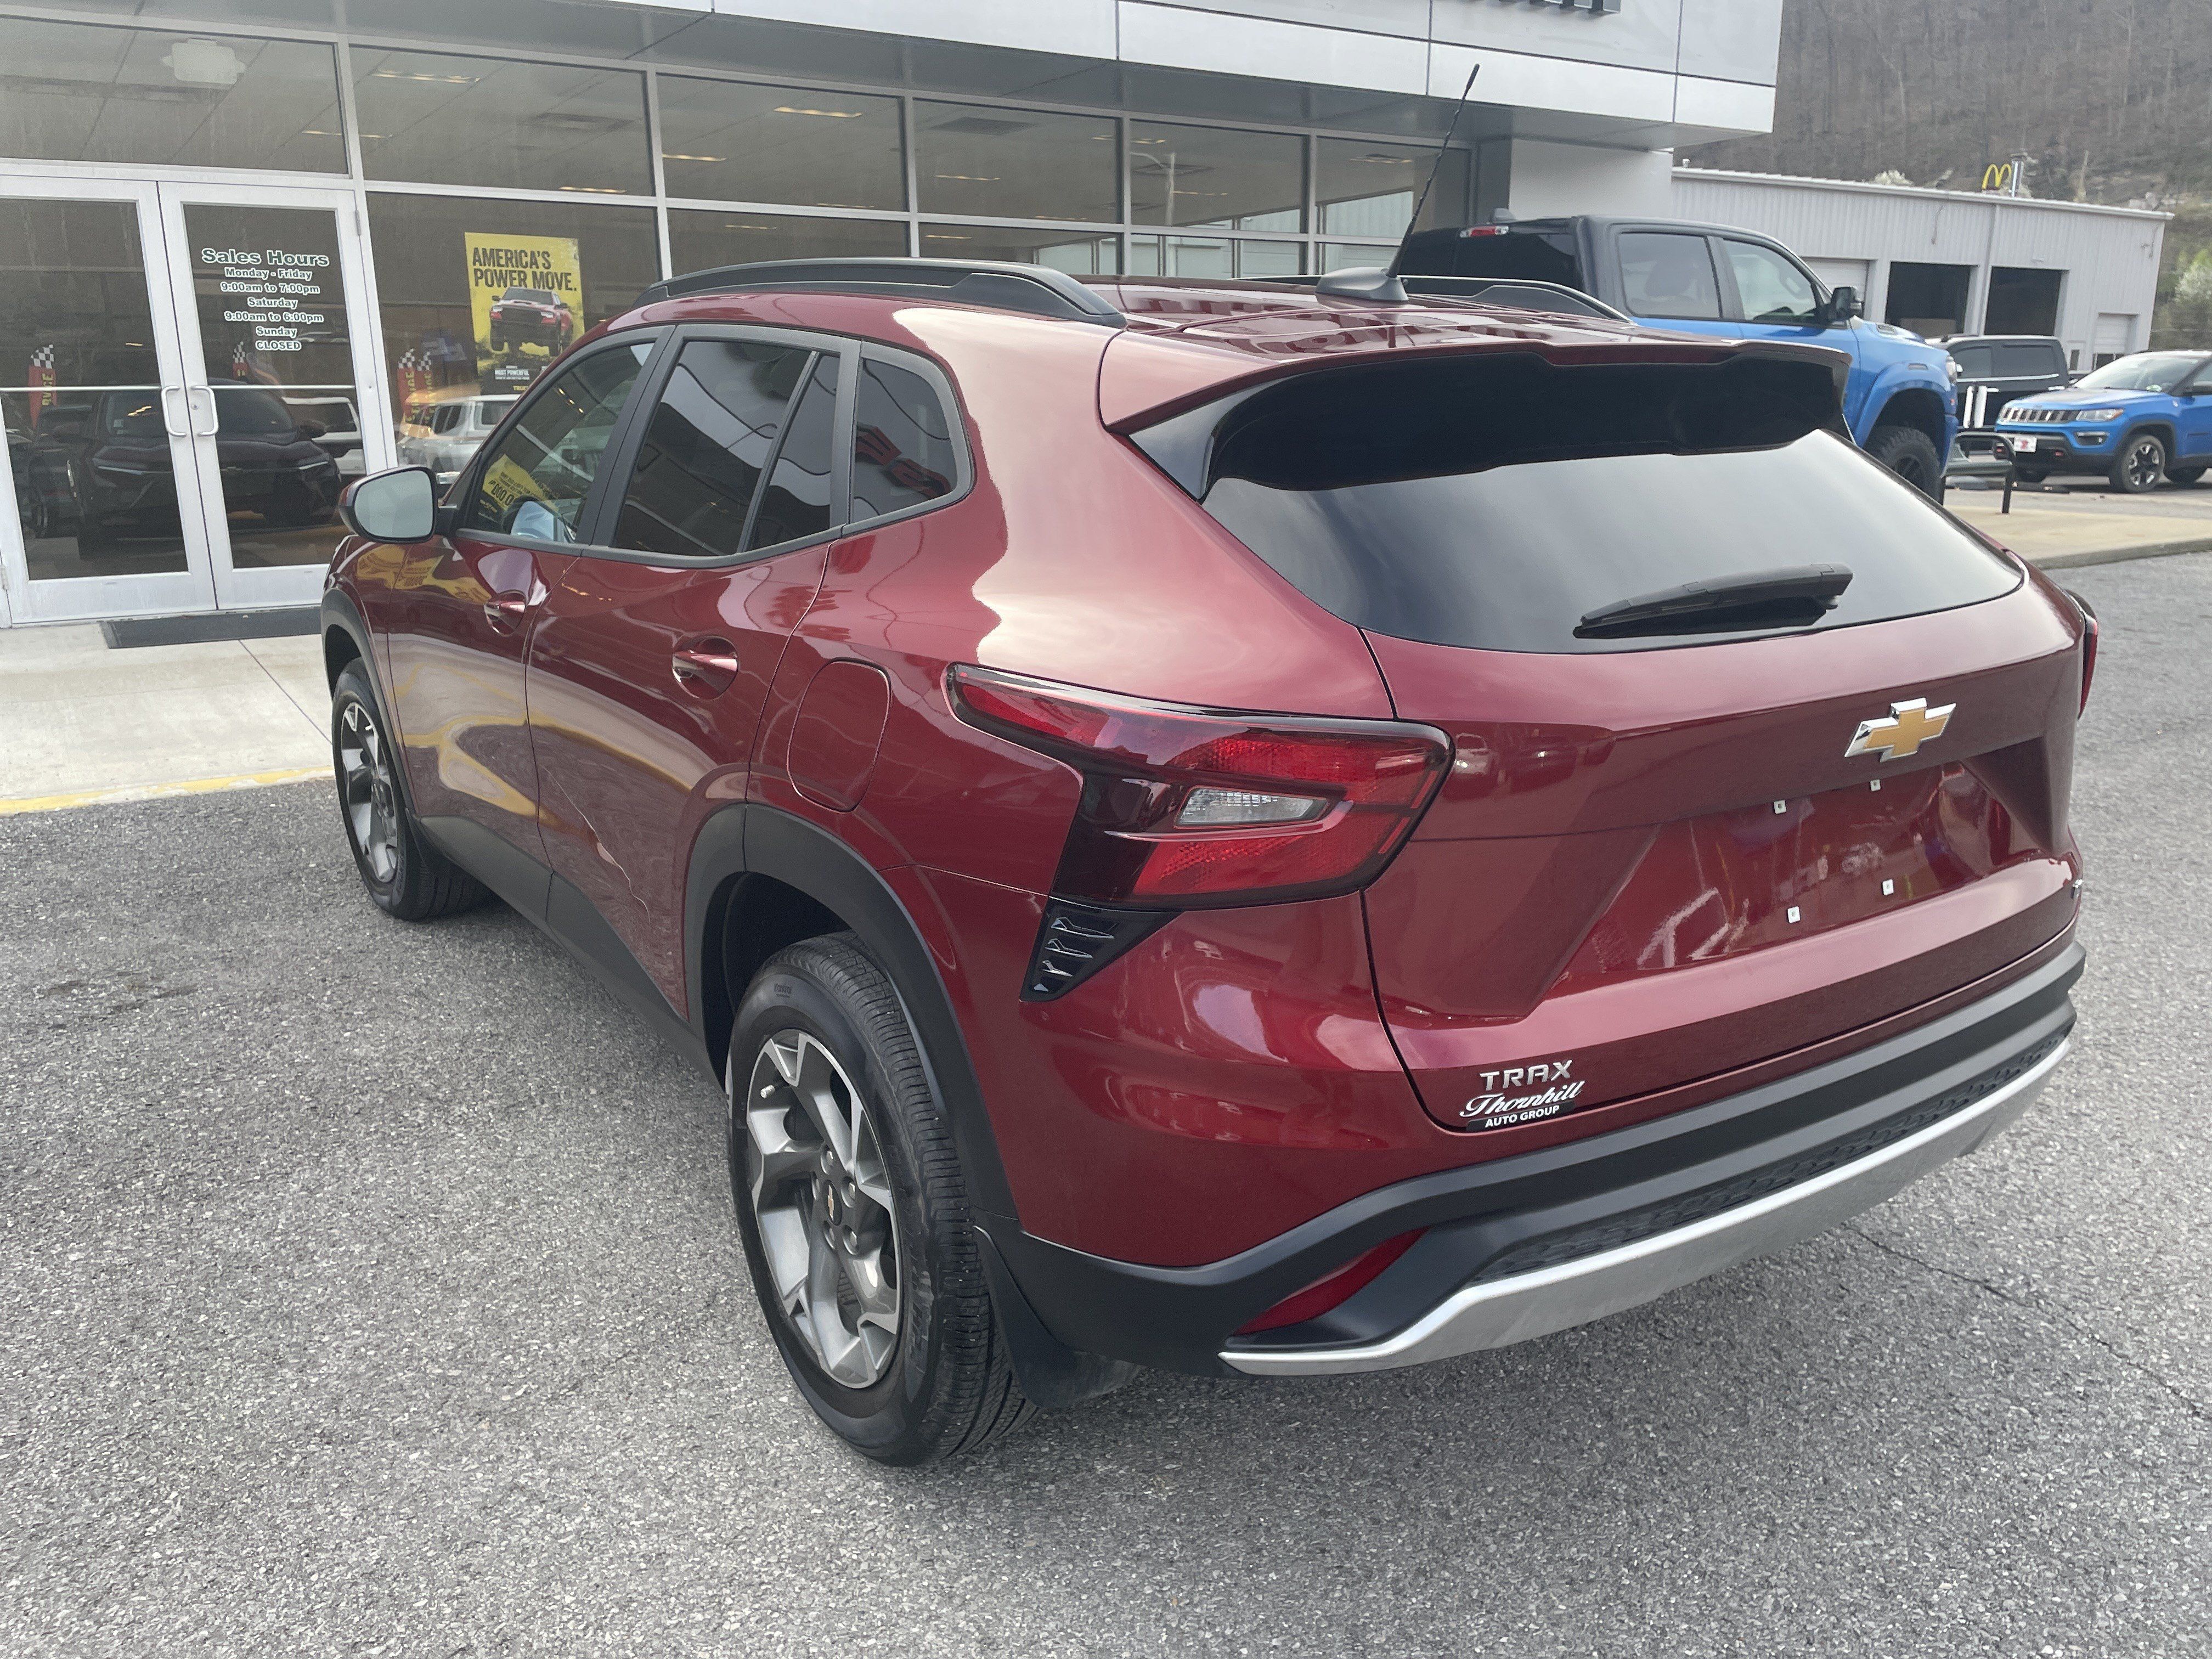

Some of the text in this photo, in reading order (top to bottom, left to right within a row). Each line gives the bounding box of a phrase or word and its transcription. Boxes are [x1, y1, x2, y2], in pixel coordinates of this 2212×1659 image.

[201, 247, 330, 267] Sales Hours
[472, 247, 551, 269] AMERICA'S
[224, 267, 269, 280] Monday
[277, 268, 313, 281] Friday
[473, 268, 577, 291] POWER MOVE.
[221, 281, 320, 295] 9:00am to 7:00pm
[247, 297, 298, 309] Saturday
[224, 311, 324, 324] 9:00am to 6:00pm
[255, 325, 298, 338] Sunday
[255, 340, 302, 351] CLOSED
[1480, 1059, 1573, 1091] TRAX
[1459, 1080, 1586, 1118] Thornhill
[1485, 1104, 1560, 1128] AUTO GROUP
